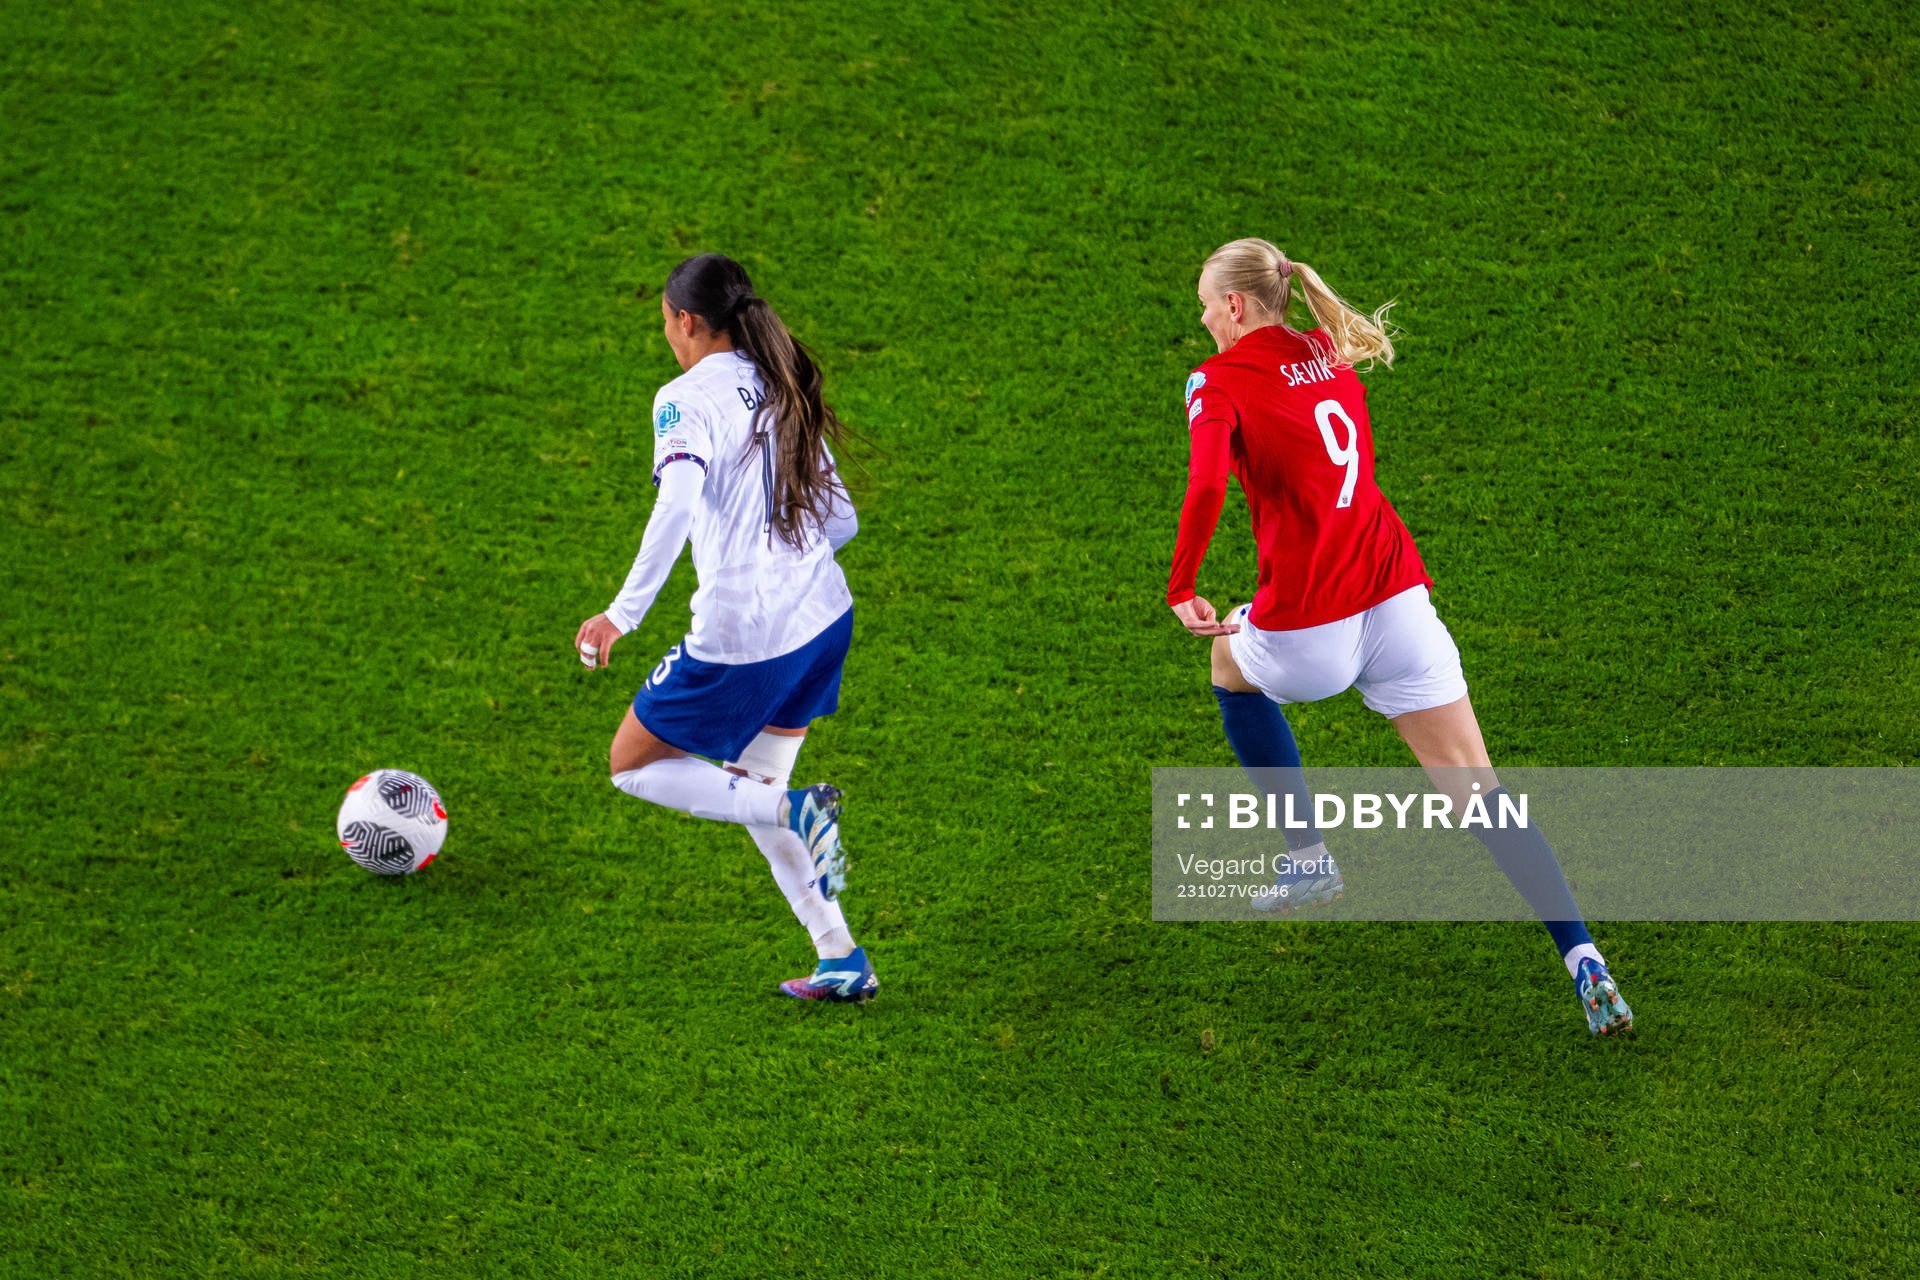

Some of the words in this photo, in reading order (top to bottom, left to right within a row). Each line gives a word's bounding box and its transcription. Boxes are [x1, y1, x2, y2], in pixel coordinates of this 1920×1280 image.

[1280, 358, 1336, 387] SÆVIK
[737, 386, 766, 411] BA
[1314, 399, 1360, 509] 9
[645, 644, 681, 691] 3
